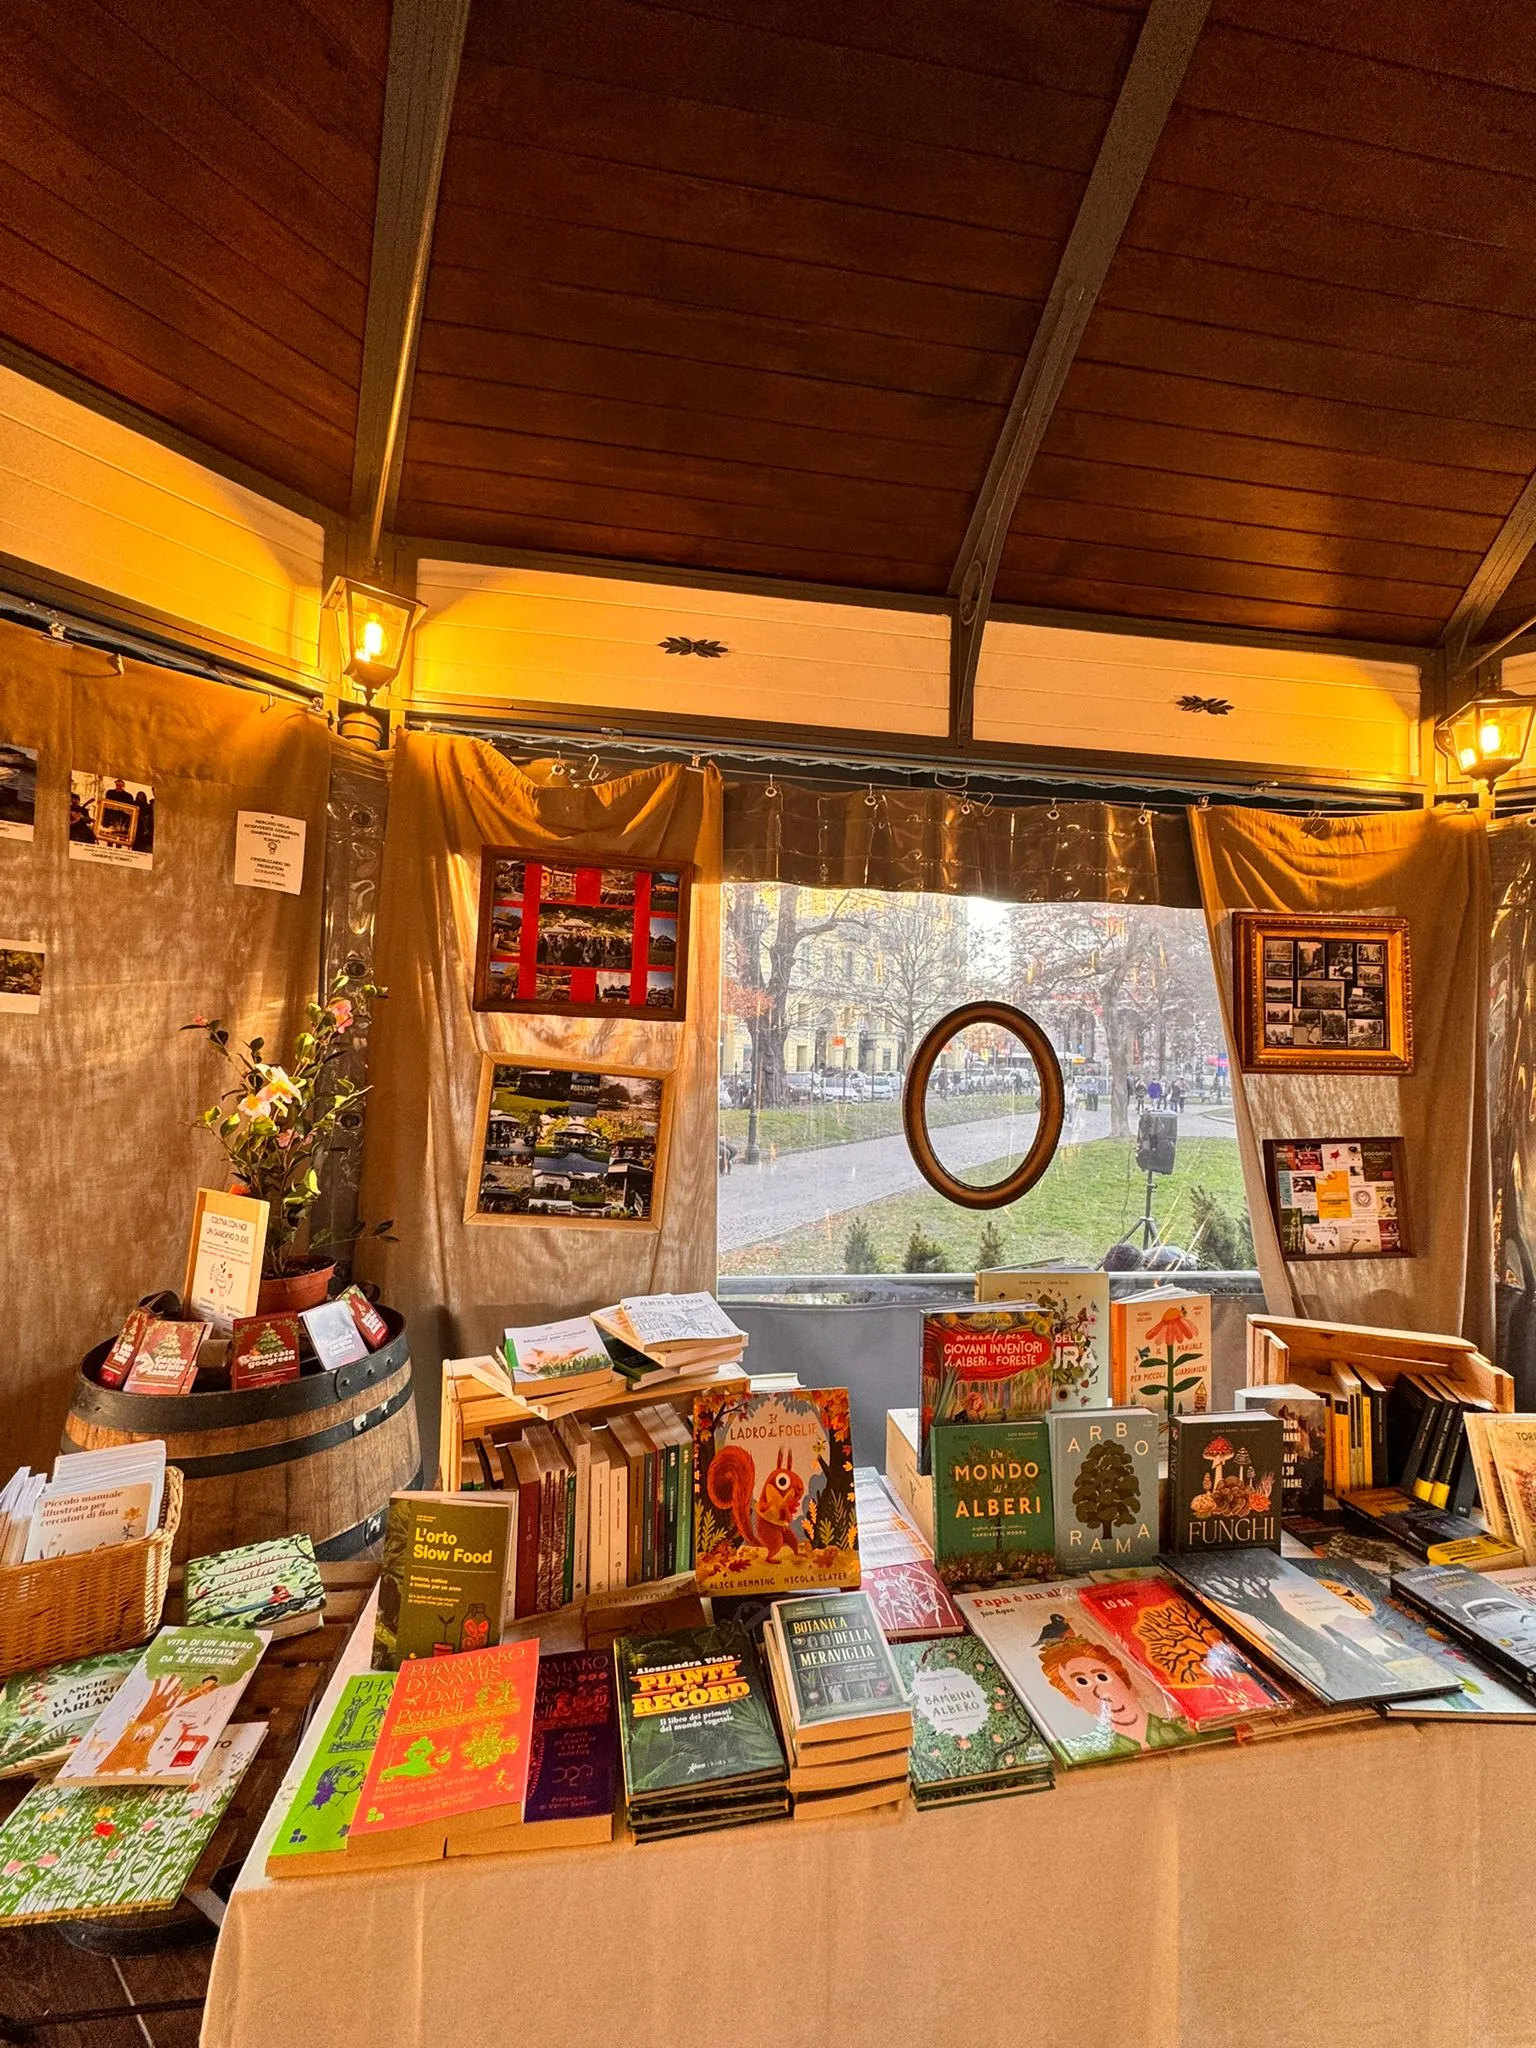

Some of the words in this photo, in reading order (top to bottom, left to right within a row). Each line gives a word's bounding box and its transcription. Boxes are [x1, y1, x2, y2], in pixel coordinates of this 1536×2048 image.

[1004, 1333, 1025, 1344] per
[1055, 1332, 1087, 1343] DELLA
[249, 1349, 296, 1361] mercato
[943, 1342, 987, 1355] GIOVANI
[989, 1340, 1043, 1355] INVENTORI
[1176, 1342, 1204, 1353] MANUALE
[247, 1354, 296, 1370] googreen
[955, 1354, 987, 1368] ALBERI
[995, 1353, 1037, 1367] FORESTE
[1143, 1371, 1166, 1381] PICCOLI
[1174, 1364, 1208, 1377] GIARDINIERI
[730, 1425, 767, 1441] LADRO
[778, 1422, 818, 1438] FOGLIE
[1283, 1453, 1298, 1464] ALPI
[954, 1461, 1040, 1482] MONDO
[44, 1496, 80, 1509] Piccolo
[81, 1490, 124, 1503] manuale
[955, 1495, 1041, 1519] ALBERI
[40, 1512, 85, 1527] cercatori
[86, 1511, 96, 1520] di
[98, 1506, 119, 1518] fiori
[42, 1504, 89, 1518] illustrato
[90, 1501, 107, 1511] per
[415, 1526, 457, 1546] L'orto
[1188, 1516, 1275, 1545] FUNGHI
[413, 1543, 451, 1561] Slow
[453, 1547, 493, 1564] Food
[709, 1580, 734, 1590] ALICE
[737, 1577, 776, 1588] HEMMING
[784, 1576, 815, 1585] NICOLA
[972, 1594, 1012, 1608] Papà
[1012, 1593, 1023, 1602] è
[1023, 1591, 1046, 1601] un
[1102, 1600, 1118, 1610] LO
[980, 1610, 995, 1618] Jon
[792, 1616, 849, 1635] BOTANICA
[167, 1638, 188, 1647] VITA
[188, 1639, 200, 1647] DI
[202, 1639, 217, 1648] UN
[219, 1640, 254, 1650] ALBERO
[833, 1627, 873, 1645] DELLA
[175, 1646, 235, 1657] RACCONTATA
[799, 1643, 876, 1668] MERAVIGLIA
[160, 1654, 174, 1664] DA
[191, 1655, 240, 1667] MEDESIMO
[408, 1647, 525, 1678] PHARMAKO
[635, 1659, 703, 1676] Alessandra
[703, 1654, 735, 1665] Viola
[405, 1665, 503, 1693] DYNAMIS
[638, 1663, 738, 1693] PIANTE
[68, 1679, 110, 1696] ANCHE
[632, 1681, 751, 1715] RECORD
[923, 1689, 977, 1706] BAMBINI
[667, 1715, 688, 1727] libro
[688, 1712, 702, 1721] dei
[702, 1707, 732, 1719] primati
[932, 1702, 981, 1718] ALBERO
[659, 1725, 673, 1734] del
[673, 1720, 703, 1732] mondo
[703, 1714, 734, 1727] vegetale
